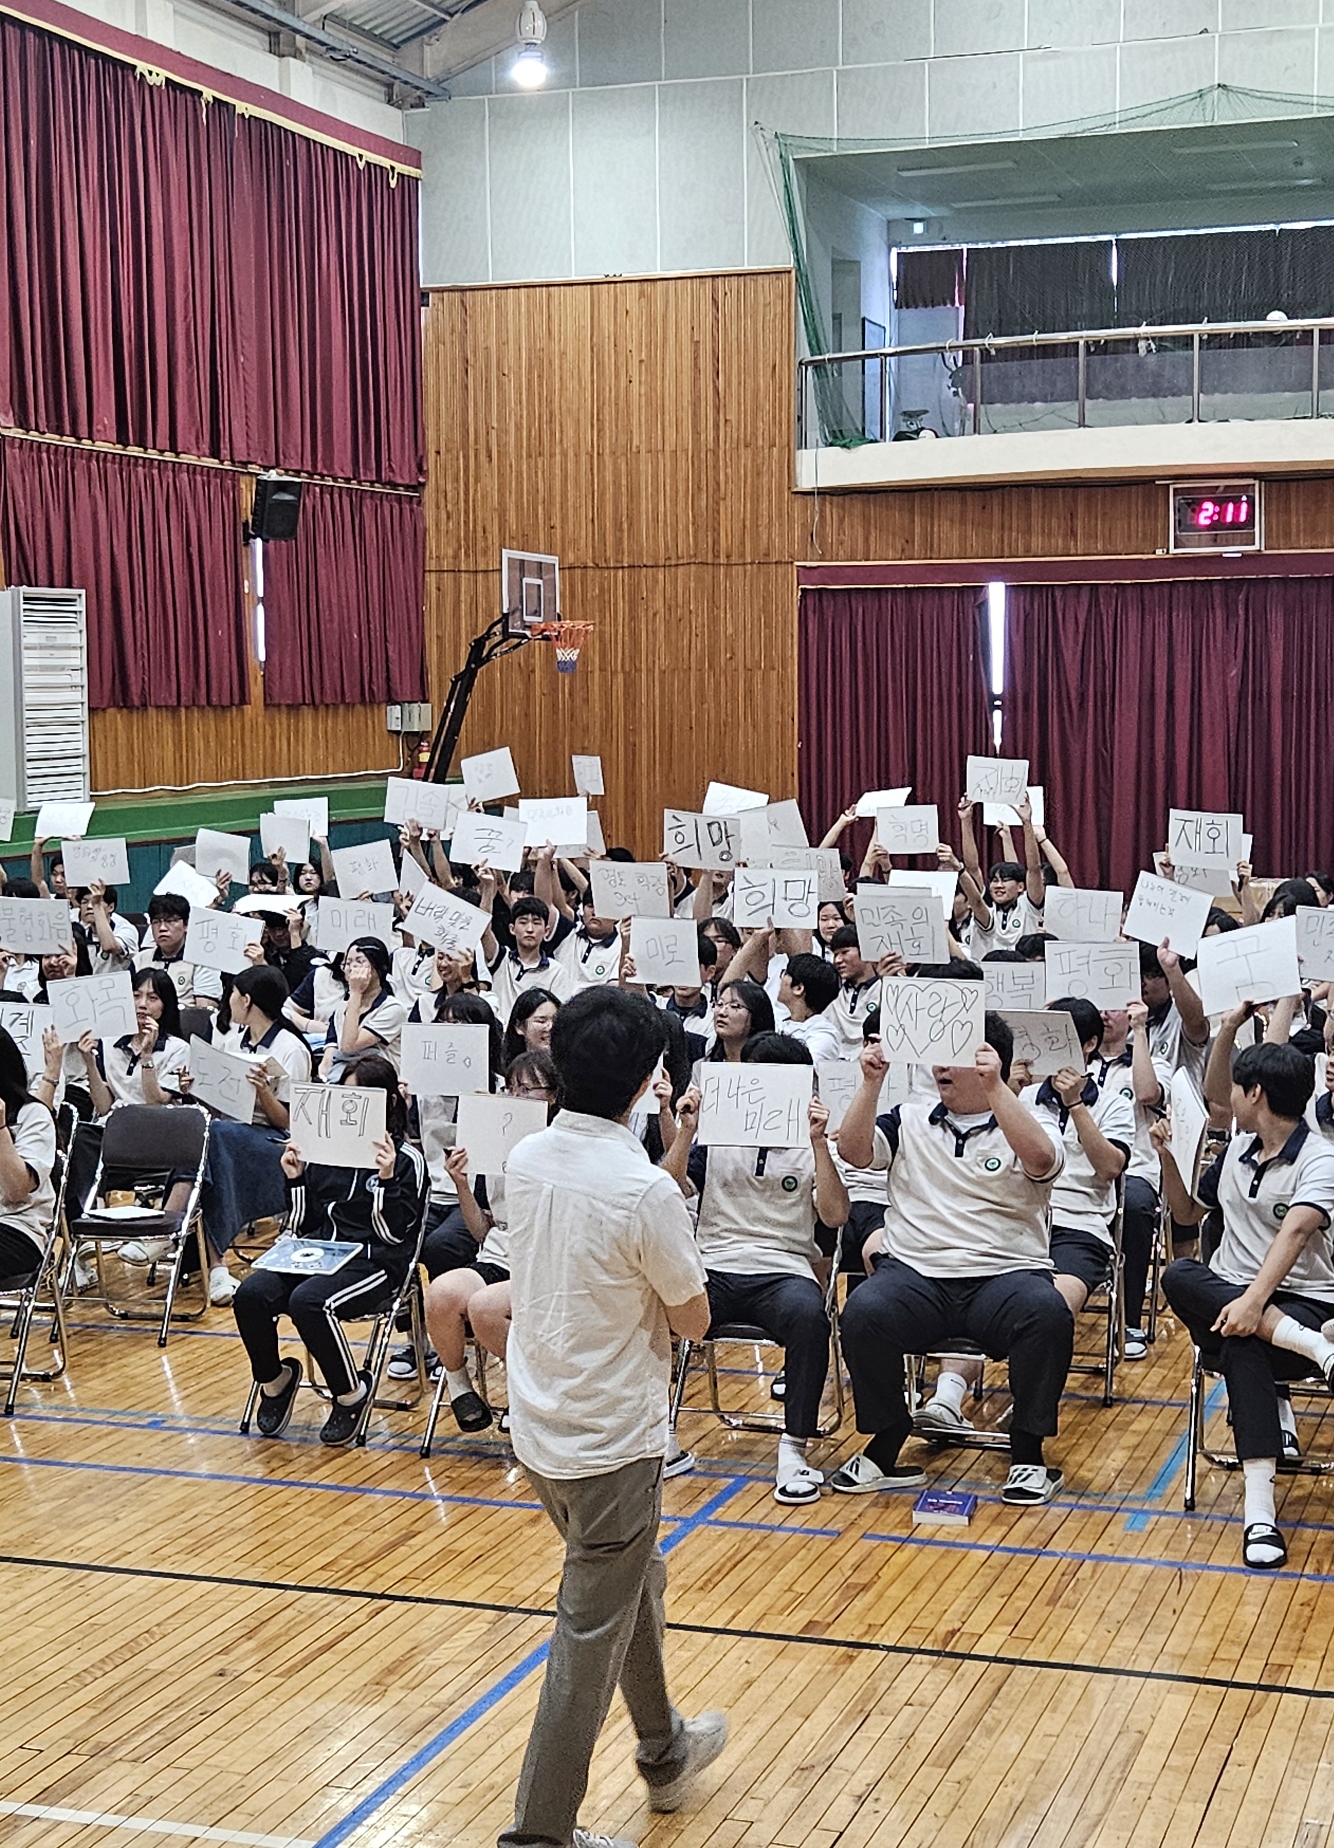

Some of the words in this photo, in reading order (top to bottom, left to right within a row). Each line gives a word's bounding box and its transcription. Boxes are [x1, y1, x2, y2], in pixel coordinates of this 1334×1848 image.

[1198, 501, 1248, 525] 2:11
[667, 814, 736, 863] 희망
[1174, 816, 1231, 859] 재회
[738, 875, 818, 918] 희망
[859, 904, 931, 929] 민족의
[1056, 892, 1111, 933] 하나
[0, 906, 69, 944] 불협화음
[195, 918, 248, 953] 평화
[330, 908, 377, 933] 미래
[869, 924, 936, 962] 재회
[984, 969, 1036, 1009] 행복
[1054, 949, 1139, 998] 평화
[59, 978, 128, 1030] 화목
[897, 990, 961, 1043] 사랑
[197, 1057, 243, 1102] 도전
[702, 1076, 720, 1115] 더
[727, 1075, 766, 1109] 나은
[293, 1086, 370, 1139] 재회
[744, 1098, 801, 1141] 미래
